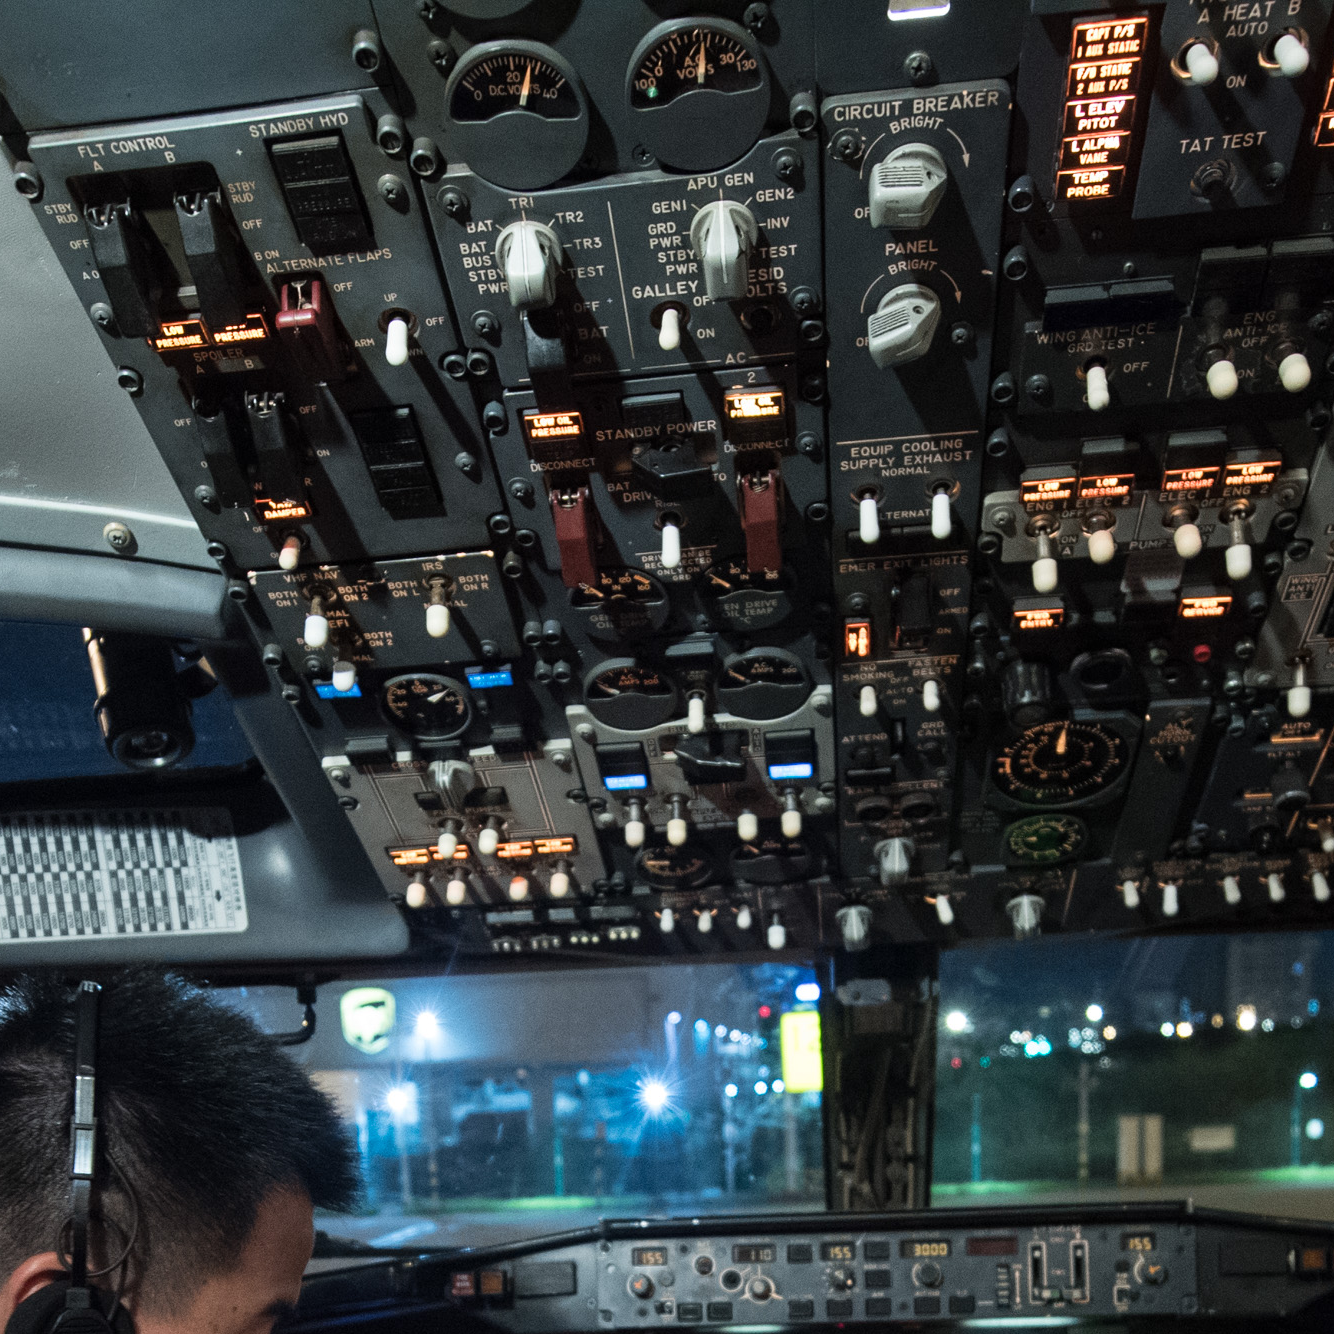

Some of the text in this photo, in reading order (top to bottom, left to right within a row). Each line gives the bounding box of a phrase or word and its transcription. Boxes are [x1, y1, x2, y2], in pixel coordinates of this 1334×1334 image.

[1223, 2, 1273, 22] HEAT
[1225, 22, 1268, 38] AUTO
[719, 52, 735, 65] 30
[736, 58, 757, 72] 130
[506, 71, 520, 82] 20
[1225, 75, 1247, 89] ON
[635, 77, 657, 90] 100
[543, 88, 558, 99] 40
[833, 91, 999, 122] CIRCUIT BREAKER
[1075, 100, 1125, 116] L ELEV
[250, 113, 349, 138] STANDBY HYD
[889, 116, 945, 135] BRIGHT
[1077, 116, 1118, 131] PITOT
[78, 136, 175, 159] FLT CONTROL
[1179, 131, 1268, 154] TAT TEST
[1079, 152, 1109, 165] VANE
[687, 172, 754, 191] APU GEN
[1072, 171, 1109, 184] TEMP
[228, 181, 256, 194] STBY
[1066, 183, 1110, 197] PROBE
[232, 191, 254, 204] RUD
[756, 187, 795, 202] GEN2
[510, 197, 534, 209] TR1
[652, 200, 687, 215] GEN1
[44, 204, 72, 217] STBY
[56, 212, 79, 224] RUD
[242, 218, 263, 230] OFF
[555, 212, 584, 223] TR2
[767, 216, 790, 229] INV
[466, 219, 494, 233] BAT
[648, 222, 677, 235] GRD
[69, 239, 89, 250] OFF
[459, 241, 486, 253] BAT
[573, 237, 603, 250] TR3
[649, 235, 682, 249] PWR
[885, 239, 938, 256] PANEL
[254, 249, 280, 261] B ON
[760, 244, 797, 258] TEST
[267, 248, 393, 274] ALTERNATE FLAPS
[463, 255, 492, 268] BUS
[888, 260, 937, 275] BRIGHT
[569, 265, 605, 279] TEST
[666, 262, 698, 276] PWR
[333, 281, 354, 293] OFF
[631, 280, 699, 299] GALLEY
[384, 293, 397, 303] UP
[425, 316, 445, 327] OFF
[163, 325, 185, 337] LOW
[214, 326, 266, 344] PRESSURE
[697, 328, 716, 340] ON
[155, 332, 204, 348] PRESSURE
[354, 337, 375, 348] ARM
[1067, 338, 1134, 353] GRD TEST
[1241, 336, 1269, 348] OFF
[725, 352, 747, 365] AC
[1123, 361, 1150, 373] OFF
[747, 372, 756, 383] 2
[299, 405, 318, 416] OFF
[174, 417, 192, 428] OFF
[533, 416, 573, 428] LOW OIL
[531, 425, 580, 438] PRESSURE
[595, 420, 717, 442] STANDBY POWER
[850, 438, 964, 458] EQUIP COOLING
[529, 458, 596, 473] DISCONNECT
[840, 451, 973, 472] SUPPLY EXHAUST
[881, 465, 931, 478] NORMAL
[607, 481, 630, 493] BAT
[1038, 481, 1060, 492] LOW
[1222, 484, 1269, 497] ENG 2
[1024, 489, 1071, 502] PRESSURE
[263, 507, 306, 519] DAMPER
[421, 562, 444, 571] IRS
[839, 554, 969, 574] EMER EXIT LIGHTS
[387, 581, 418, 592] BOTH
[458, 574, 489, 586] BOTH
[268, 591, 298, 602] BOTH
